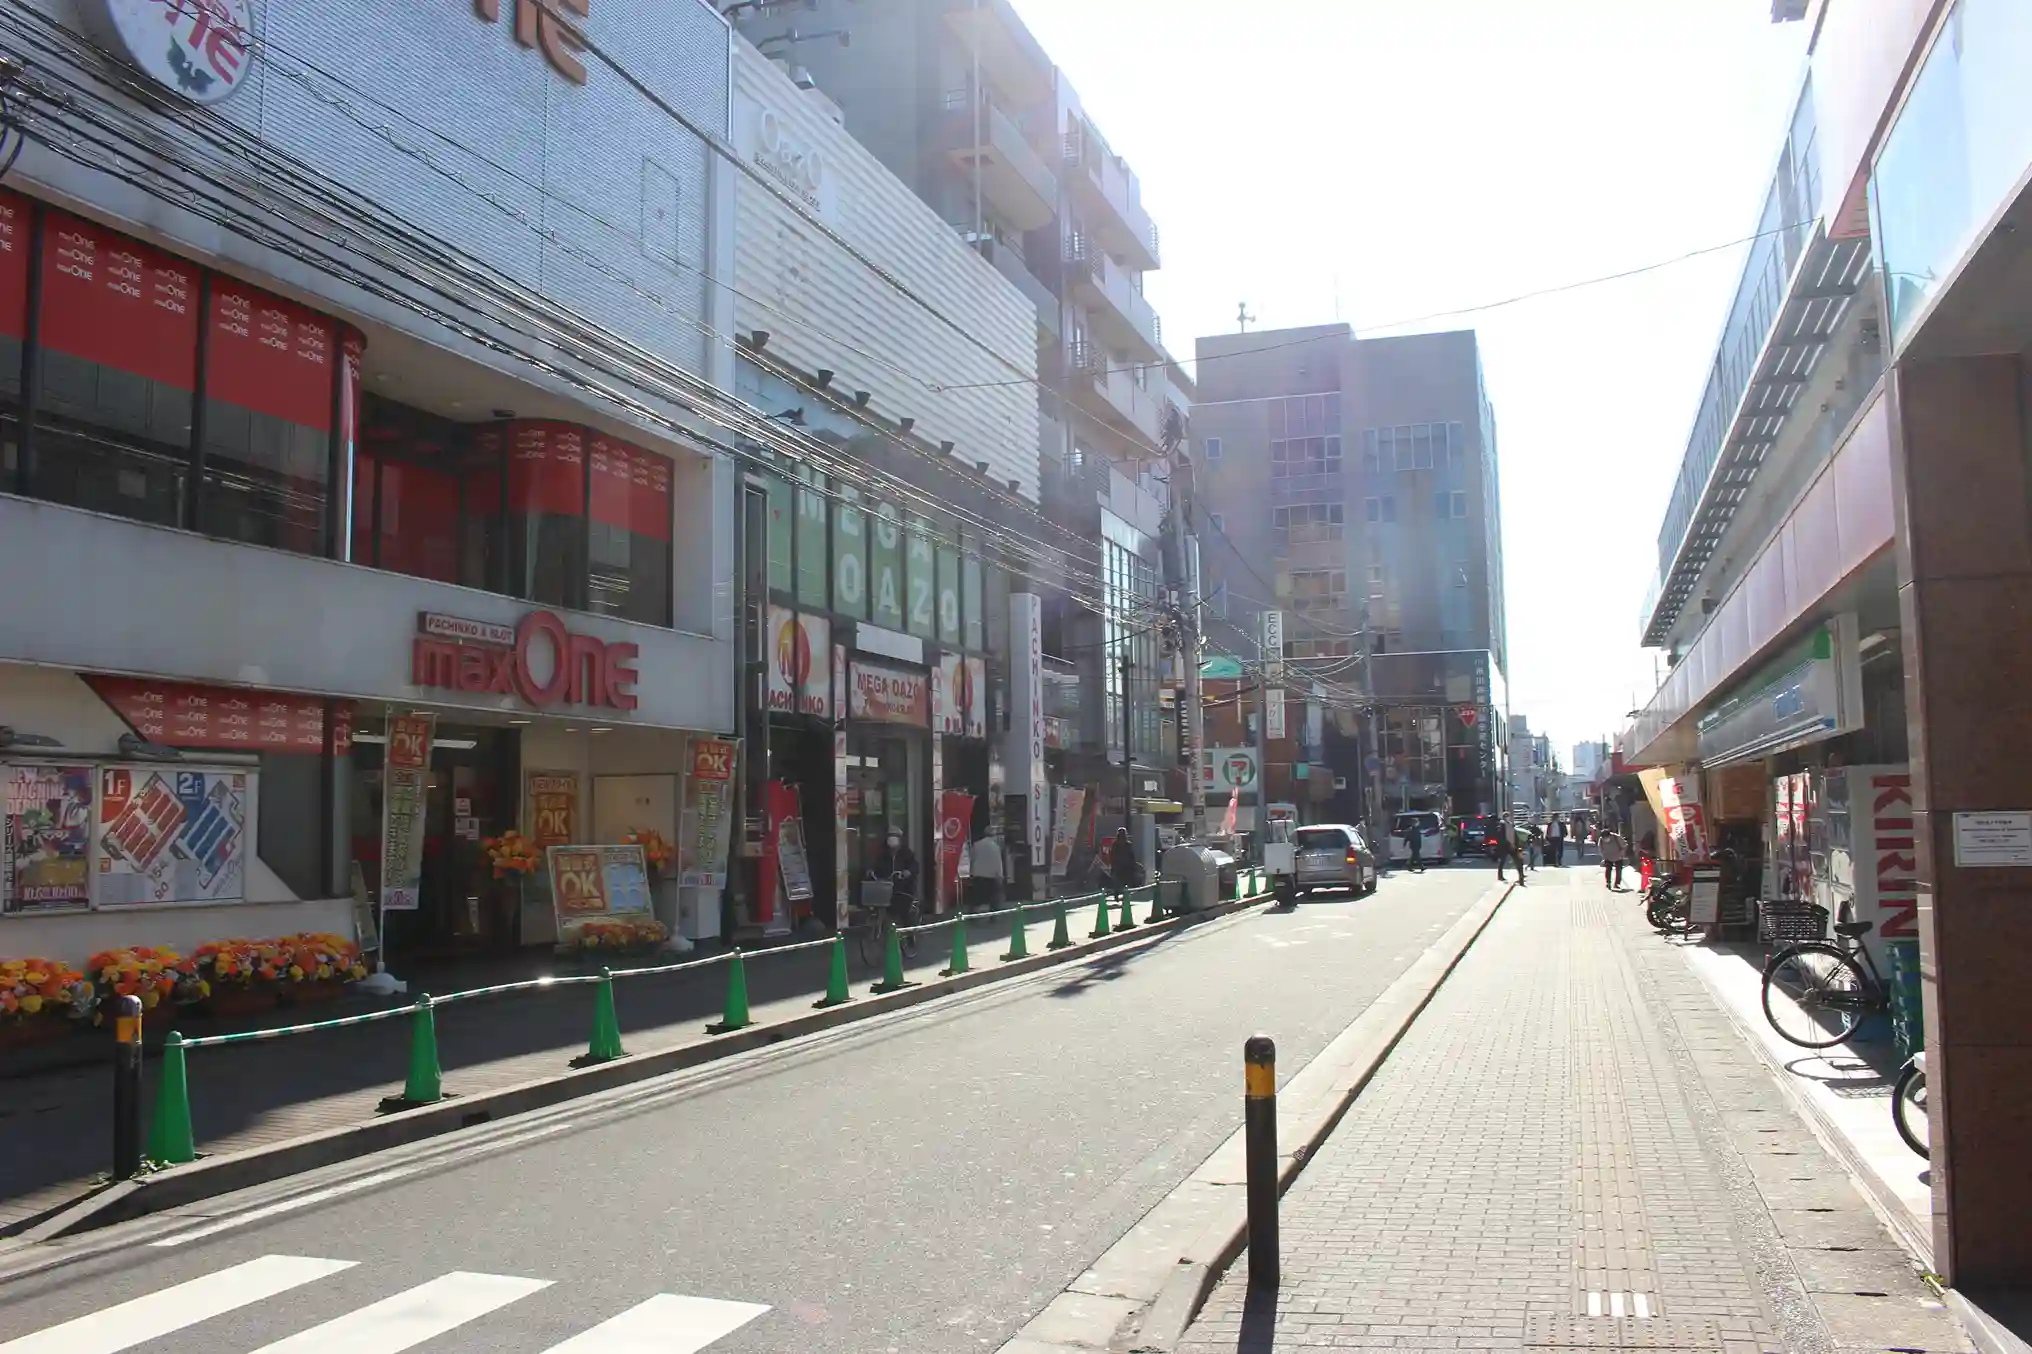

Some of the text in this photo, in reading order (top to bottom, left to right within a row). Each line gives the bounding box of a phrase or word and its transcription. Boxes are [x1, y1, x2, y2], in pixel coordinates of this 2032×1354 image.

[839, 553, 958, 631] OAZO
[428, 616, 478, 636] PACHINKO
[1267, 613, 1278, 647] ECC
[857, 672, 889, 694] MEGA
[1030, 601, 1042, 760] PACHINKO
[766, 688, 824, 714] ACHNKO
[697, 752, 728, 772] OK
[104, 770, 126, 796] 1F
[179, 772, 202, 795] 2F
[538, 809, 568, 836] OK
[1033, 783, 1043, 865] SLOT
[1871, 773, 1920, 938] KIRIN
[560, 871, 602, 899] OK
